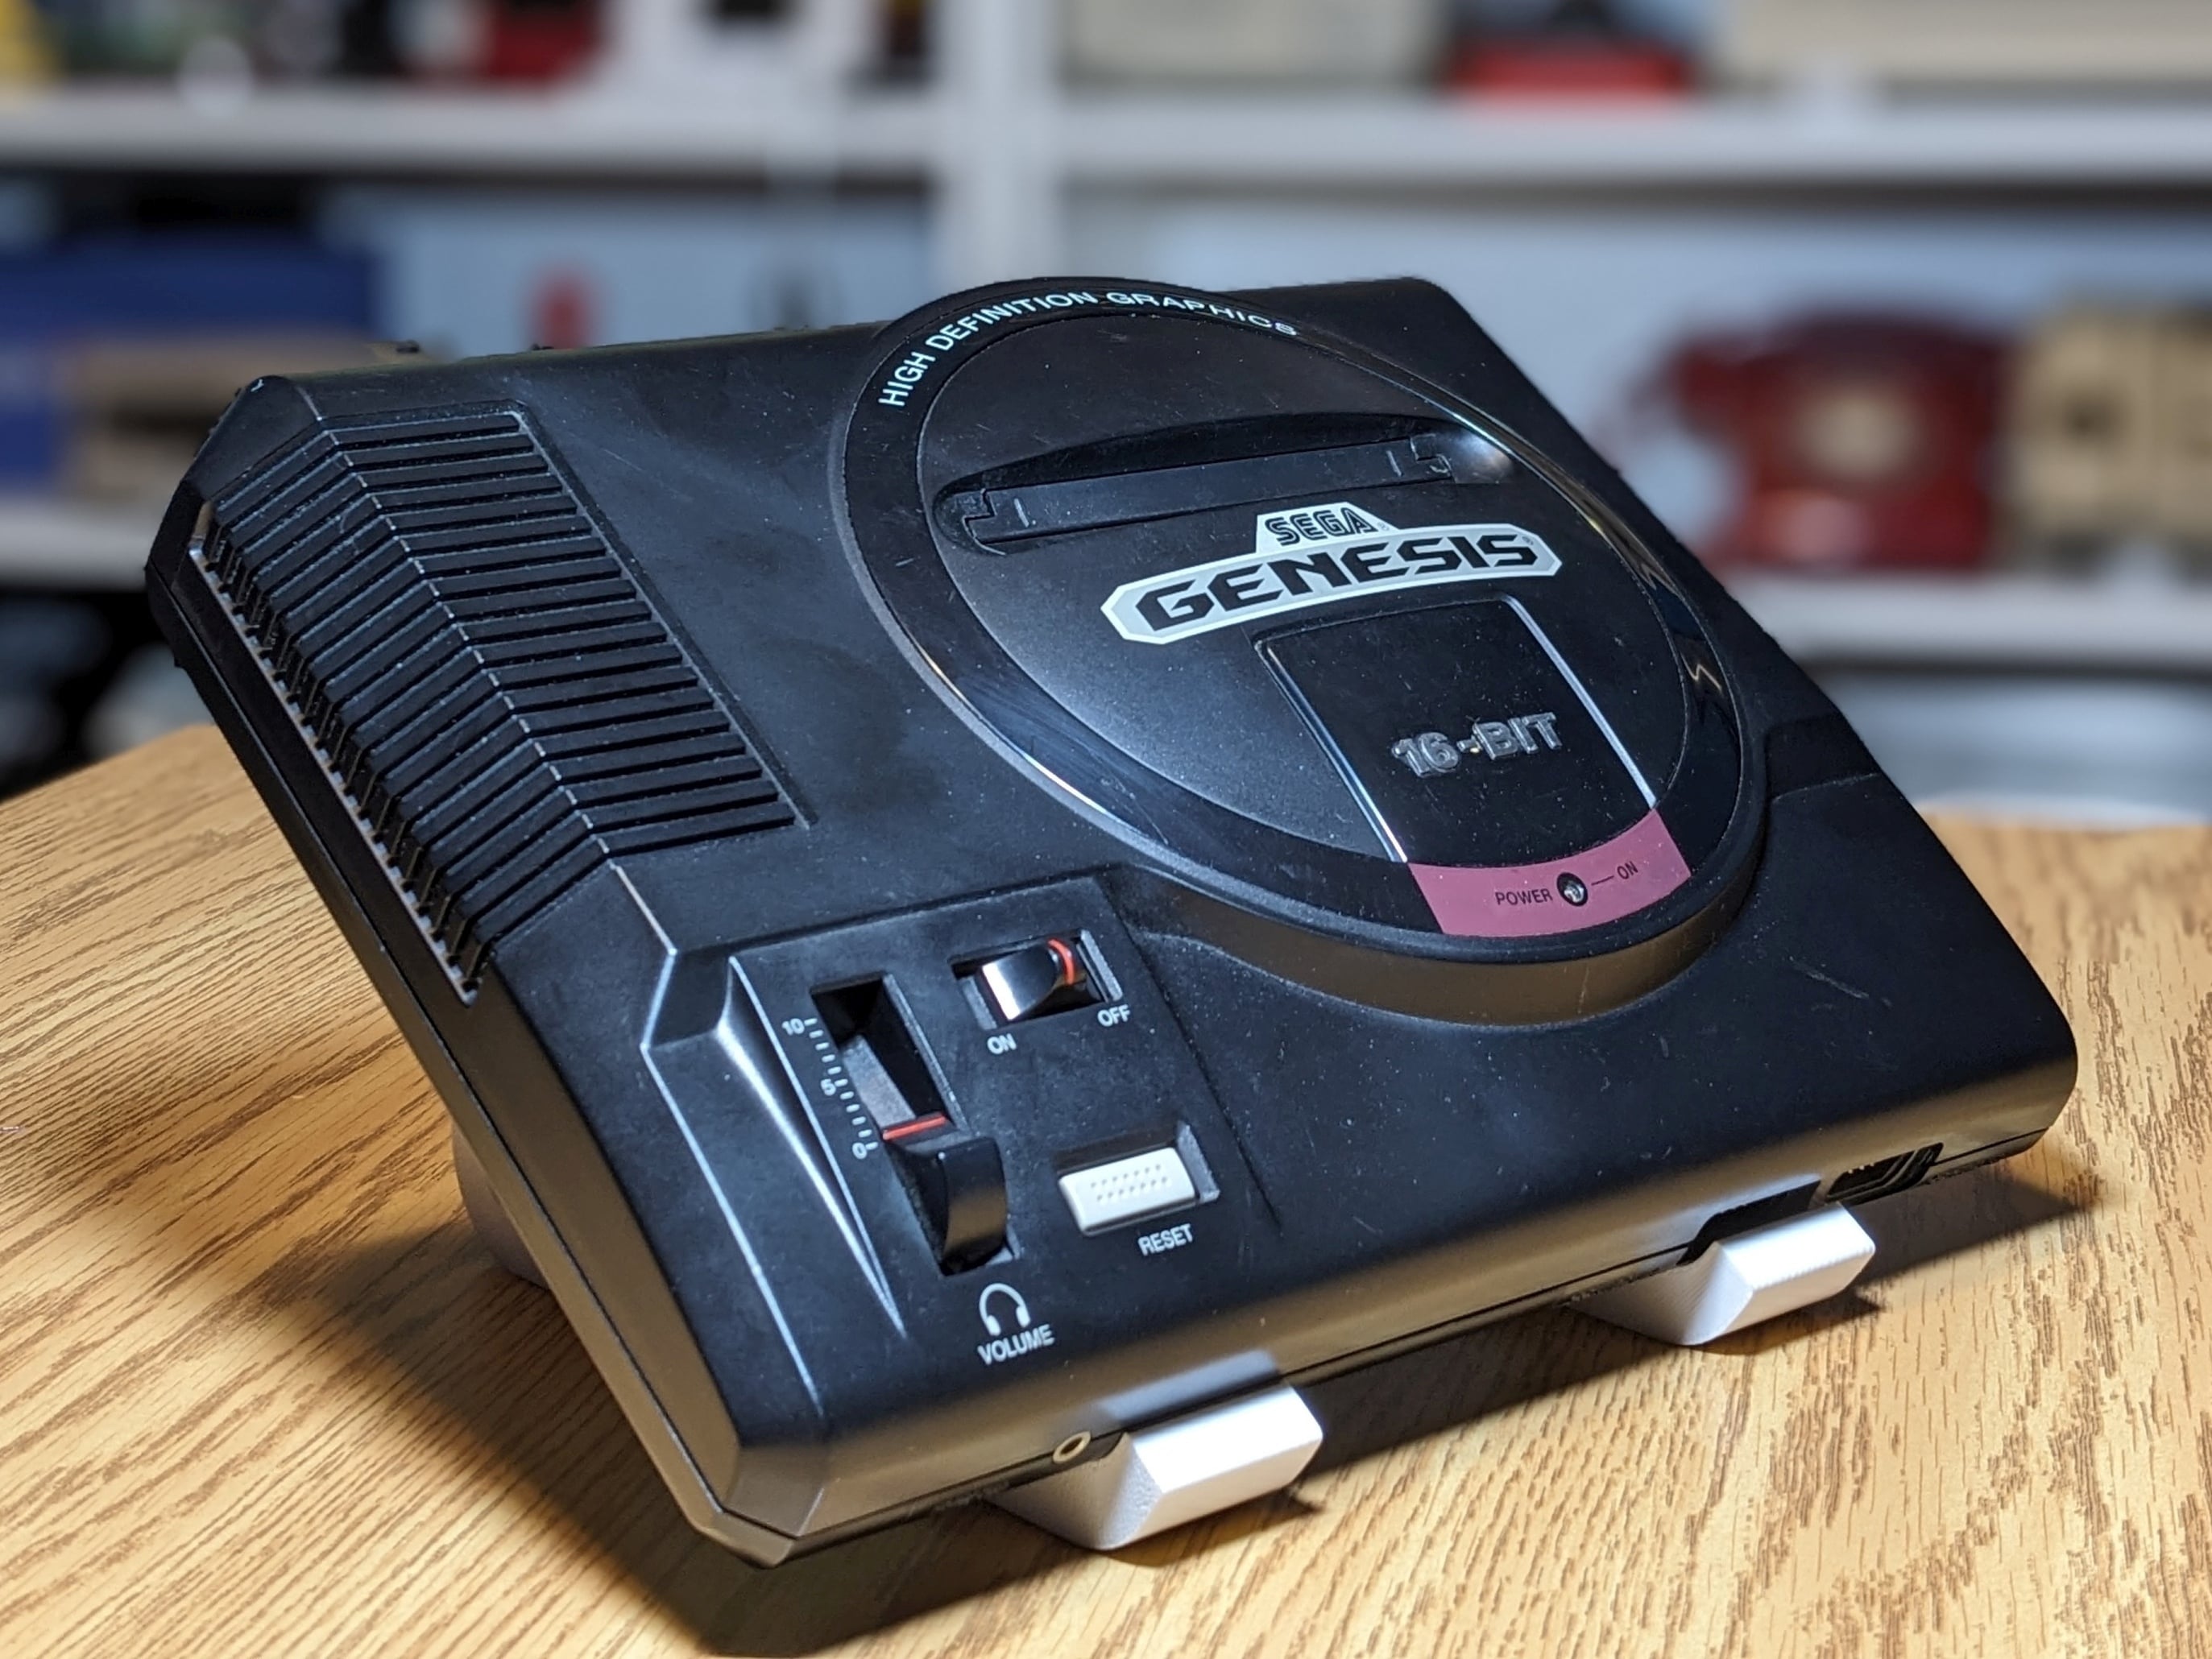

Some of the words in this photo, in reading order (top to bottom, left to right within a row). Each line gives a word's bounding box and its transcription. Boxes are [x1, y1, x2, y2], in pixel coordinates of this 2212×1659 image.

[879, 351, 935, 407] HIGH
[925, 292, 1098, 351] DEFINITION
[1105, 292, 1299, 336] GRAPHICS
[1265, 506, 1377, 545] SEGA
[1135, 534, 1539, 631] GENESIS
[1391, 712, 1563, 778] 16-BIT
[1495, 889, 1553, 906] POWER
[1616, 861, 1638, 880] ON
[781, 1019, 805, 1035] 10
[988, 1034, 1017, 1055] ON
[1098, 1006, 1131, 1028] OFF
[821, 1080, 836, 1094] 5
[852, 1142, 868, 1159] 0
[1137, 1224, 1193, 1256] RESET
[978, 1323, 1054, 1365] VOLUME
